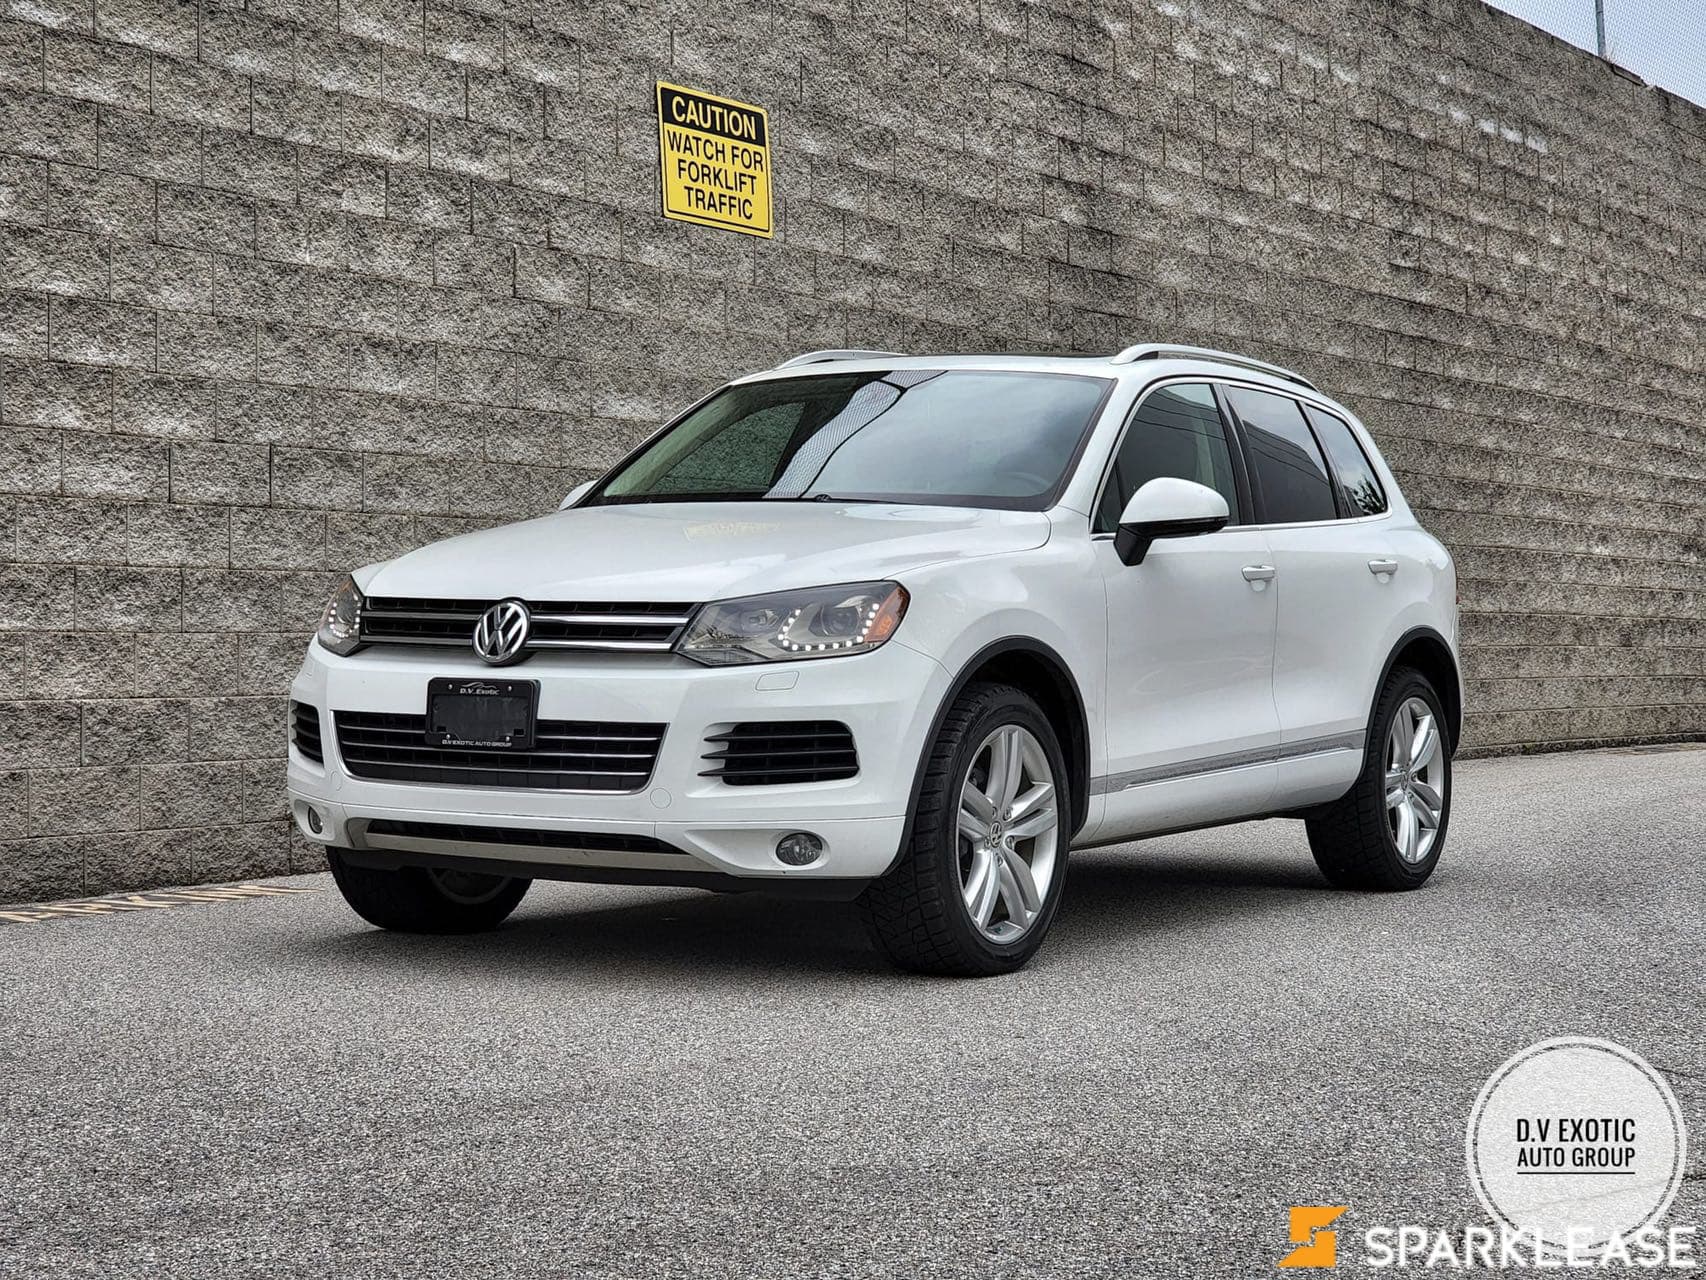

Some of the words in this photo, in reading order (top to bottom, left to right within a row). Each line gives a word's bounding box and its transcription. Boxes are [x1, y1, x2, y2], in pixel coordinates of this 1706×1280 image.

[671, 95, 757, 141] CAUTION
[666, 129, 726, 164] WATCH
[731, 145, 764, 172] FOR
[677, 158, 757, 196] FORKLIFT
[684, 186, 753, 220] TRAFFIC
